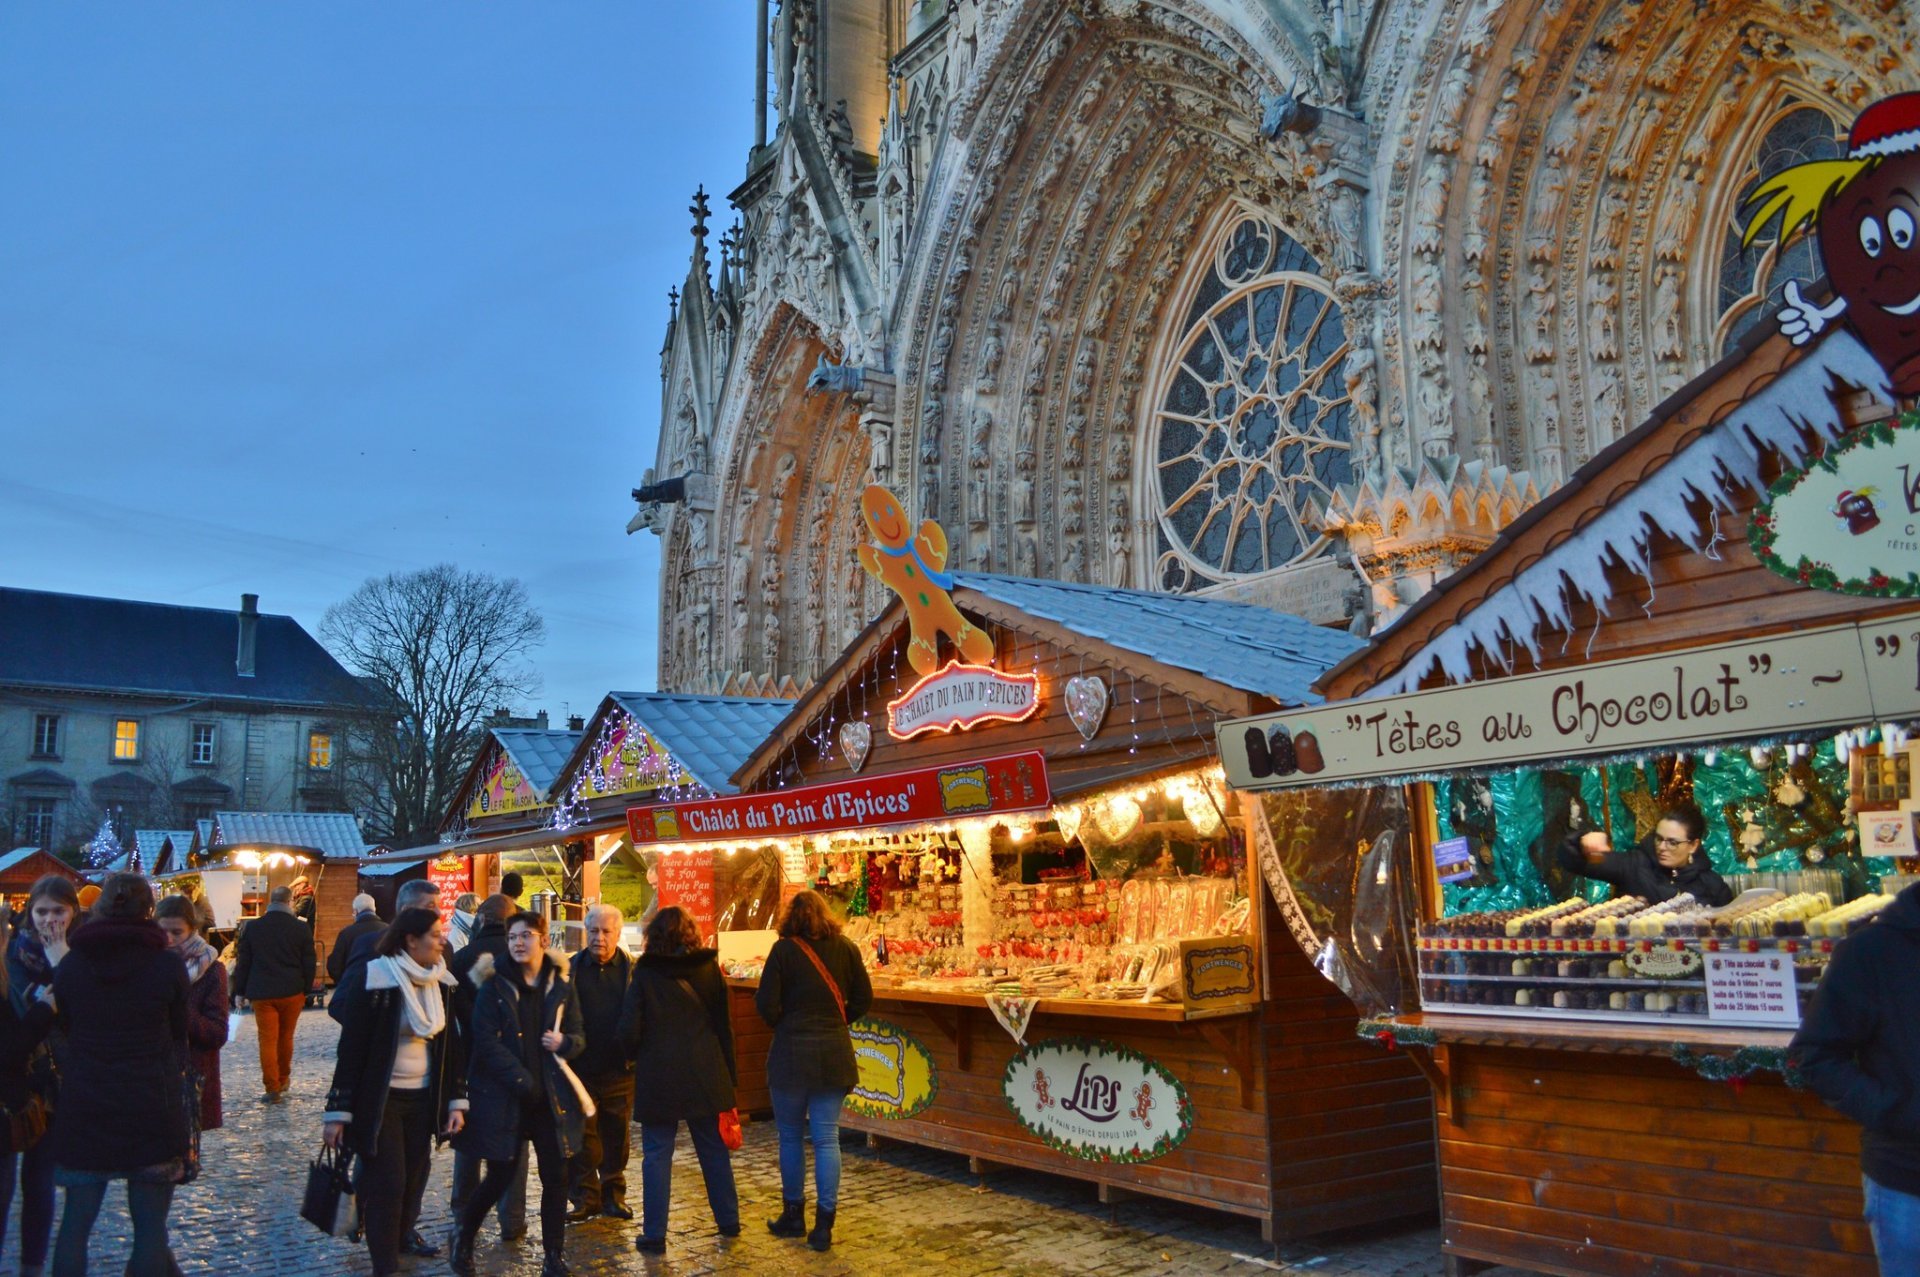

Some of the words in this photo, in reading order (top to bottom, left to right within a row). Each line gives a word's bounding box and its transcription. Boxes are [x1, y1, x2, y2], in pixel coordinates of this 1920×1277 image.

[895, 706, 905, 727] LE
[905, 692, 935, 723] CHALET
[937, 689, 950, 708] DU
[951, 681, 975, 704] PAIN
[1482, 712, 1532, 743] au
[618, 775, 633, 791] FAIT
[635, 770, 666, 788] MAISON
[745, 804, 767, 829] du
[771, 799, 817, 827] Pain
[661, 857, 682, 867] Bière
[684, 857, 693, 867] de
[695, 856, 713, 867] Noël
[665, 880, 689, 891] Triple
[693, 881, 710, 890] Pan
[1196, 958, 1244, 976] FORTWENGER
[1728, 979, 1736, 987] de
[1728, 991, 1735, 999] de
[1729, 1003, 1735, 1011] de
[1047, 1114, 1055, 1123] LE
[1055, 1119, 1070, 1132] PAIN
[1097, 1130, 1121, 1140] DEPUIS
